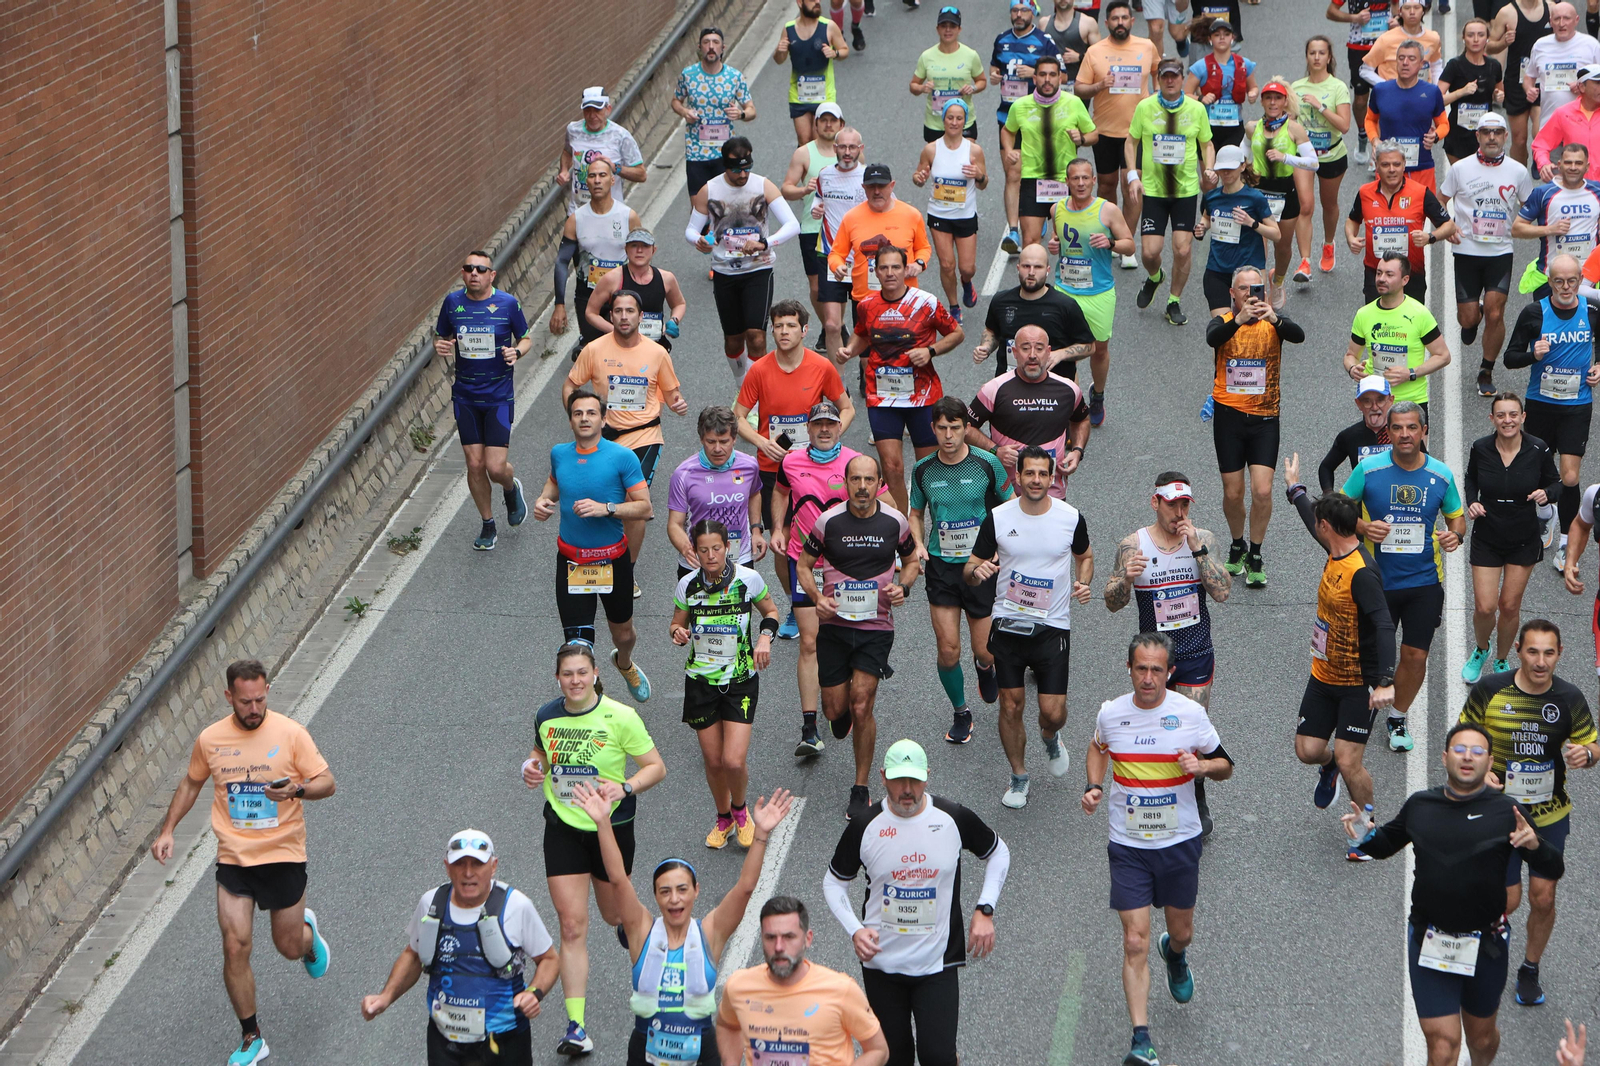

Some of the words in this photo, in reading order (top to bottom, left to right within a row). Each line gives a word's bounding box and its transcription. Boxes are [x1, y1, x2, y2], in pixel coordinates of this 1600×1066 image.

[1560, 204, 1592, 215] OTIS
[1374, 217, 1382, 225] CA
[1383, 216, 1406, 226] GERENA
[1567, 235, 1589, 243] ZURICH
[1541, 330, 1591, 344] FRANCE
[622, 377, 645, 385] ZURICH
[706, 491, 745, 506] Jove
[950, 520, 975, 530] ZURICH
[950, 533, 969, 541] 10071
[582, 567, 599, 576] 6195
[1151, 569, 1167, 578] CLUB
[847, 582, 875, 590] ZURICH
[1023, 577, 1050, 587] ZURICH
[1020, 589, 1037, 598] 7082
[846, 595, 865, 603] 10484
[1169, 602, 1185, 611] 7891
[707, 637, 723, 645] 8293
[1521, 722, 1539, 732] CLUB
[546, 727, 592, 740] RUNNING
[1511, 731, 1549, 744] ATLETISMO
[1133, 735, 1157, 745] Luis
[549, 739, 582, 752] MAGIC
[551, 752, 573, 764] BOX
[565, 766, 593, 774] ZURICH
[1524, 763, 1552, 772] ZURICH
[1521, 778, 1543, 786] 10077
[241, 799, 262, 808] 11298
[1143, 796, 1172, 805] ZURICH
[1142, 812, 1161, 820] 8819
[879, 825, 898, 839] edp
[900, 851, 927, 864] edp
[898, 890, 930, 899] ZURICH
[897, 905, 918, 914] 9352
[897, 917, 919, 925] Manuel
[662, 972, 682, 987] SB
[448, 996, 480, 1007] ZURICH
[664, 1023, 696, 1034] ZURICH
[748, 1023, 778, 1033] Maratón
[660, 1038, 685, 1051] 11593
[769, 1045, 804, 1053] ZURICH
